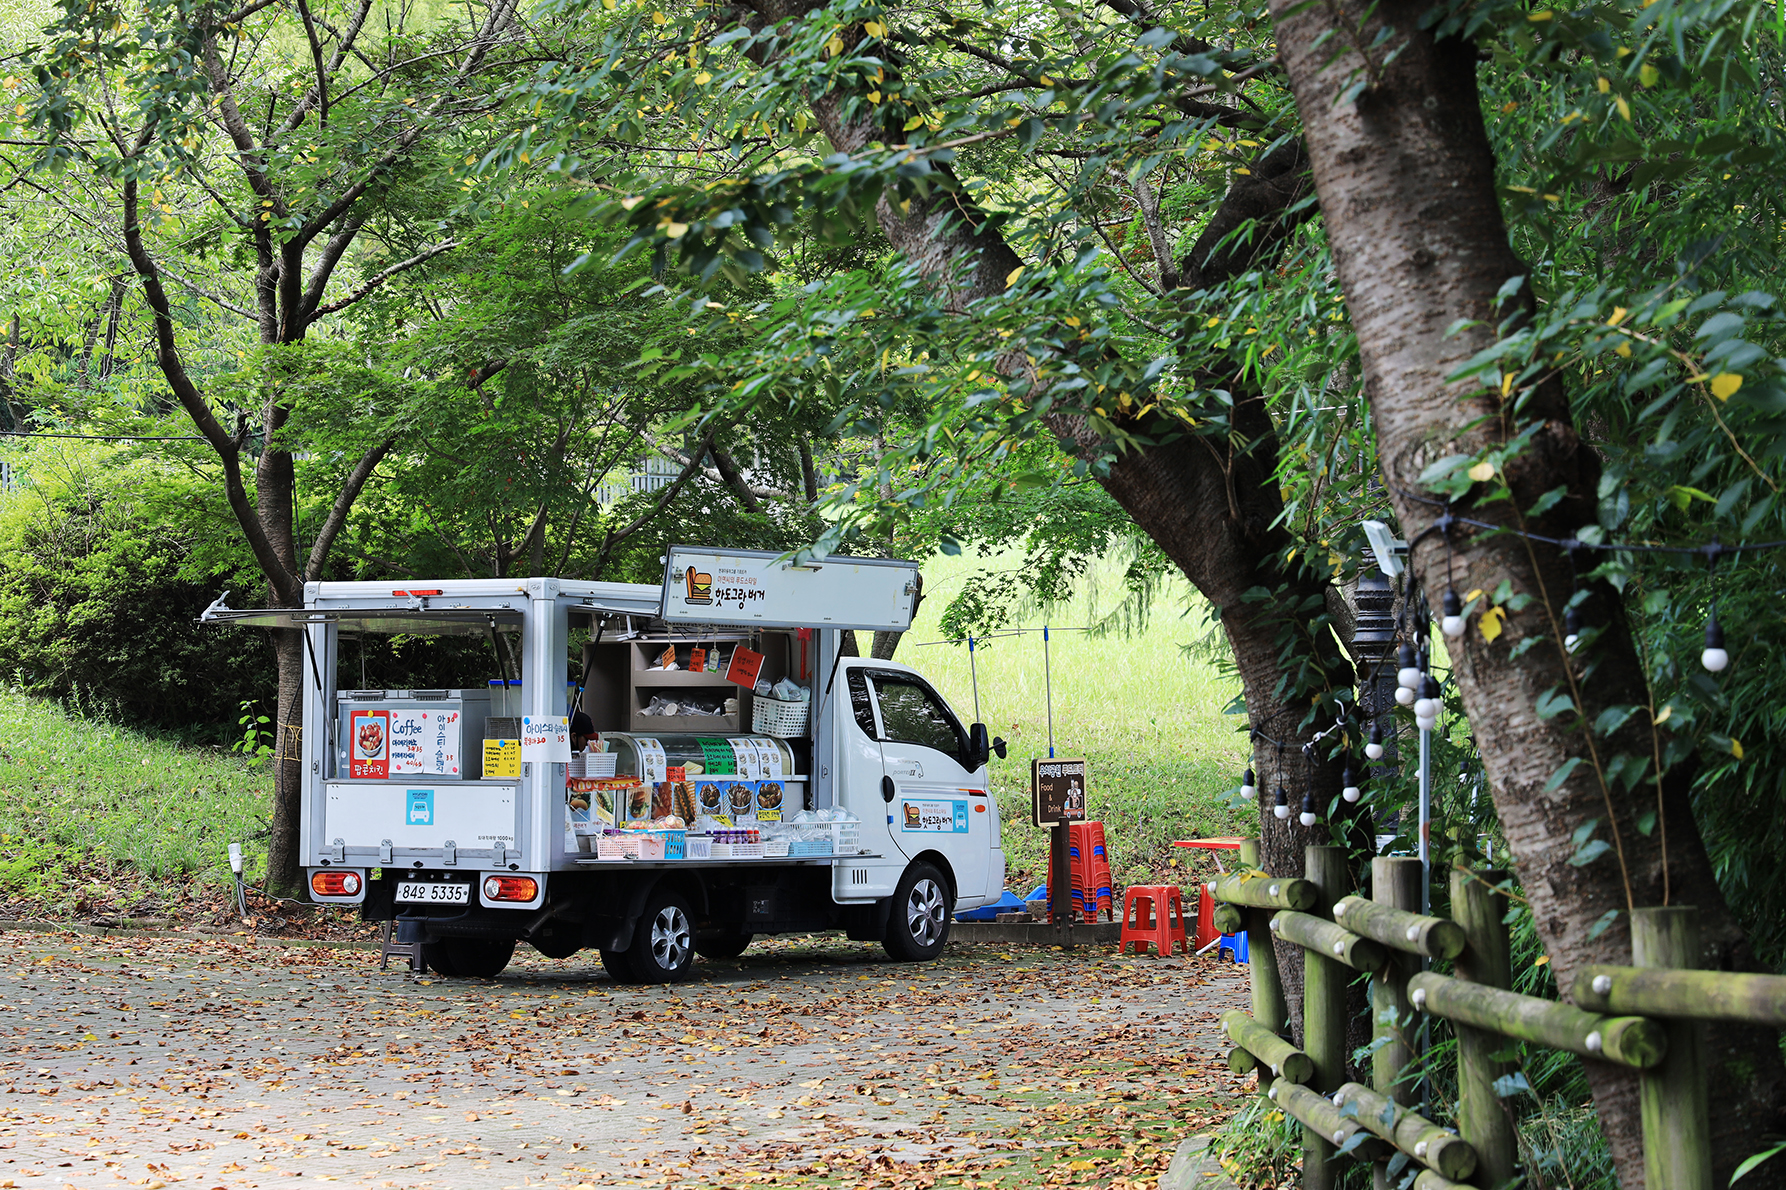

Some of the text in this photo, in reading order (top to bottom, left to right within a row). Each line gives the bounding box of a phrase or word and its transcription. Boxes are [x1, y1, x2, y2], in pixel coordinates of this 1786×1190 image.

[715, 587, 765, 610] 핫도그랑 버거
[391, 719, 422, 736] Coffee
[354, 764, 384, 776] 팝콘치킨
[1040, 783, 1054, 792] Food
[402, 885, 463, 900] 84오 5335
